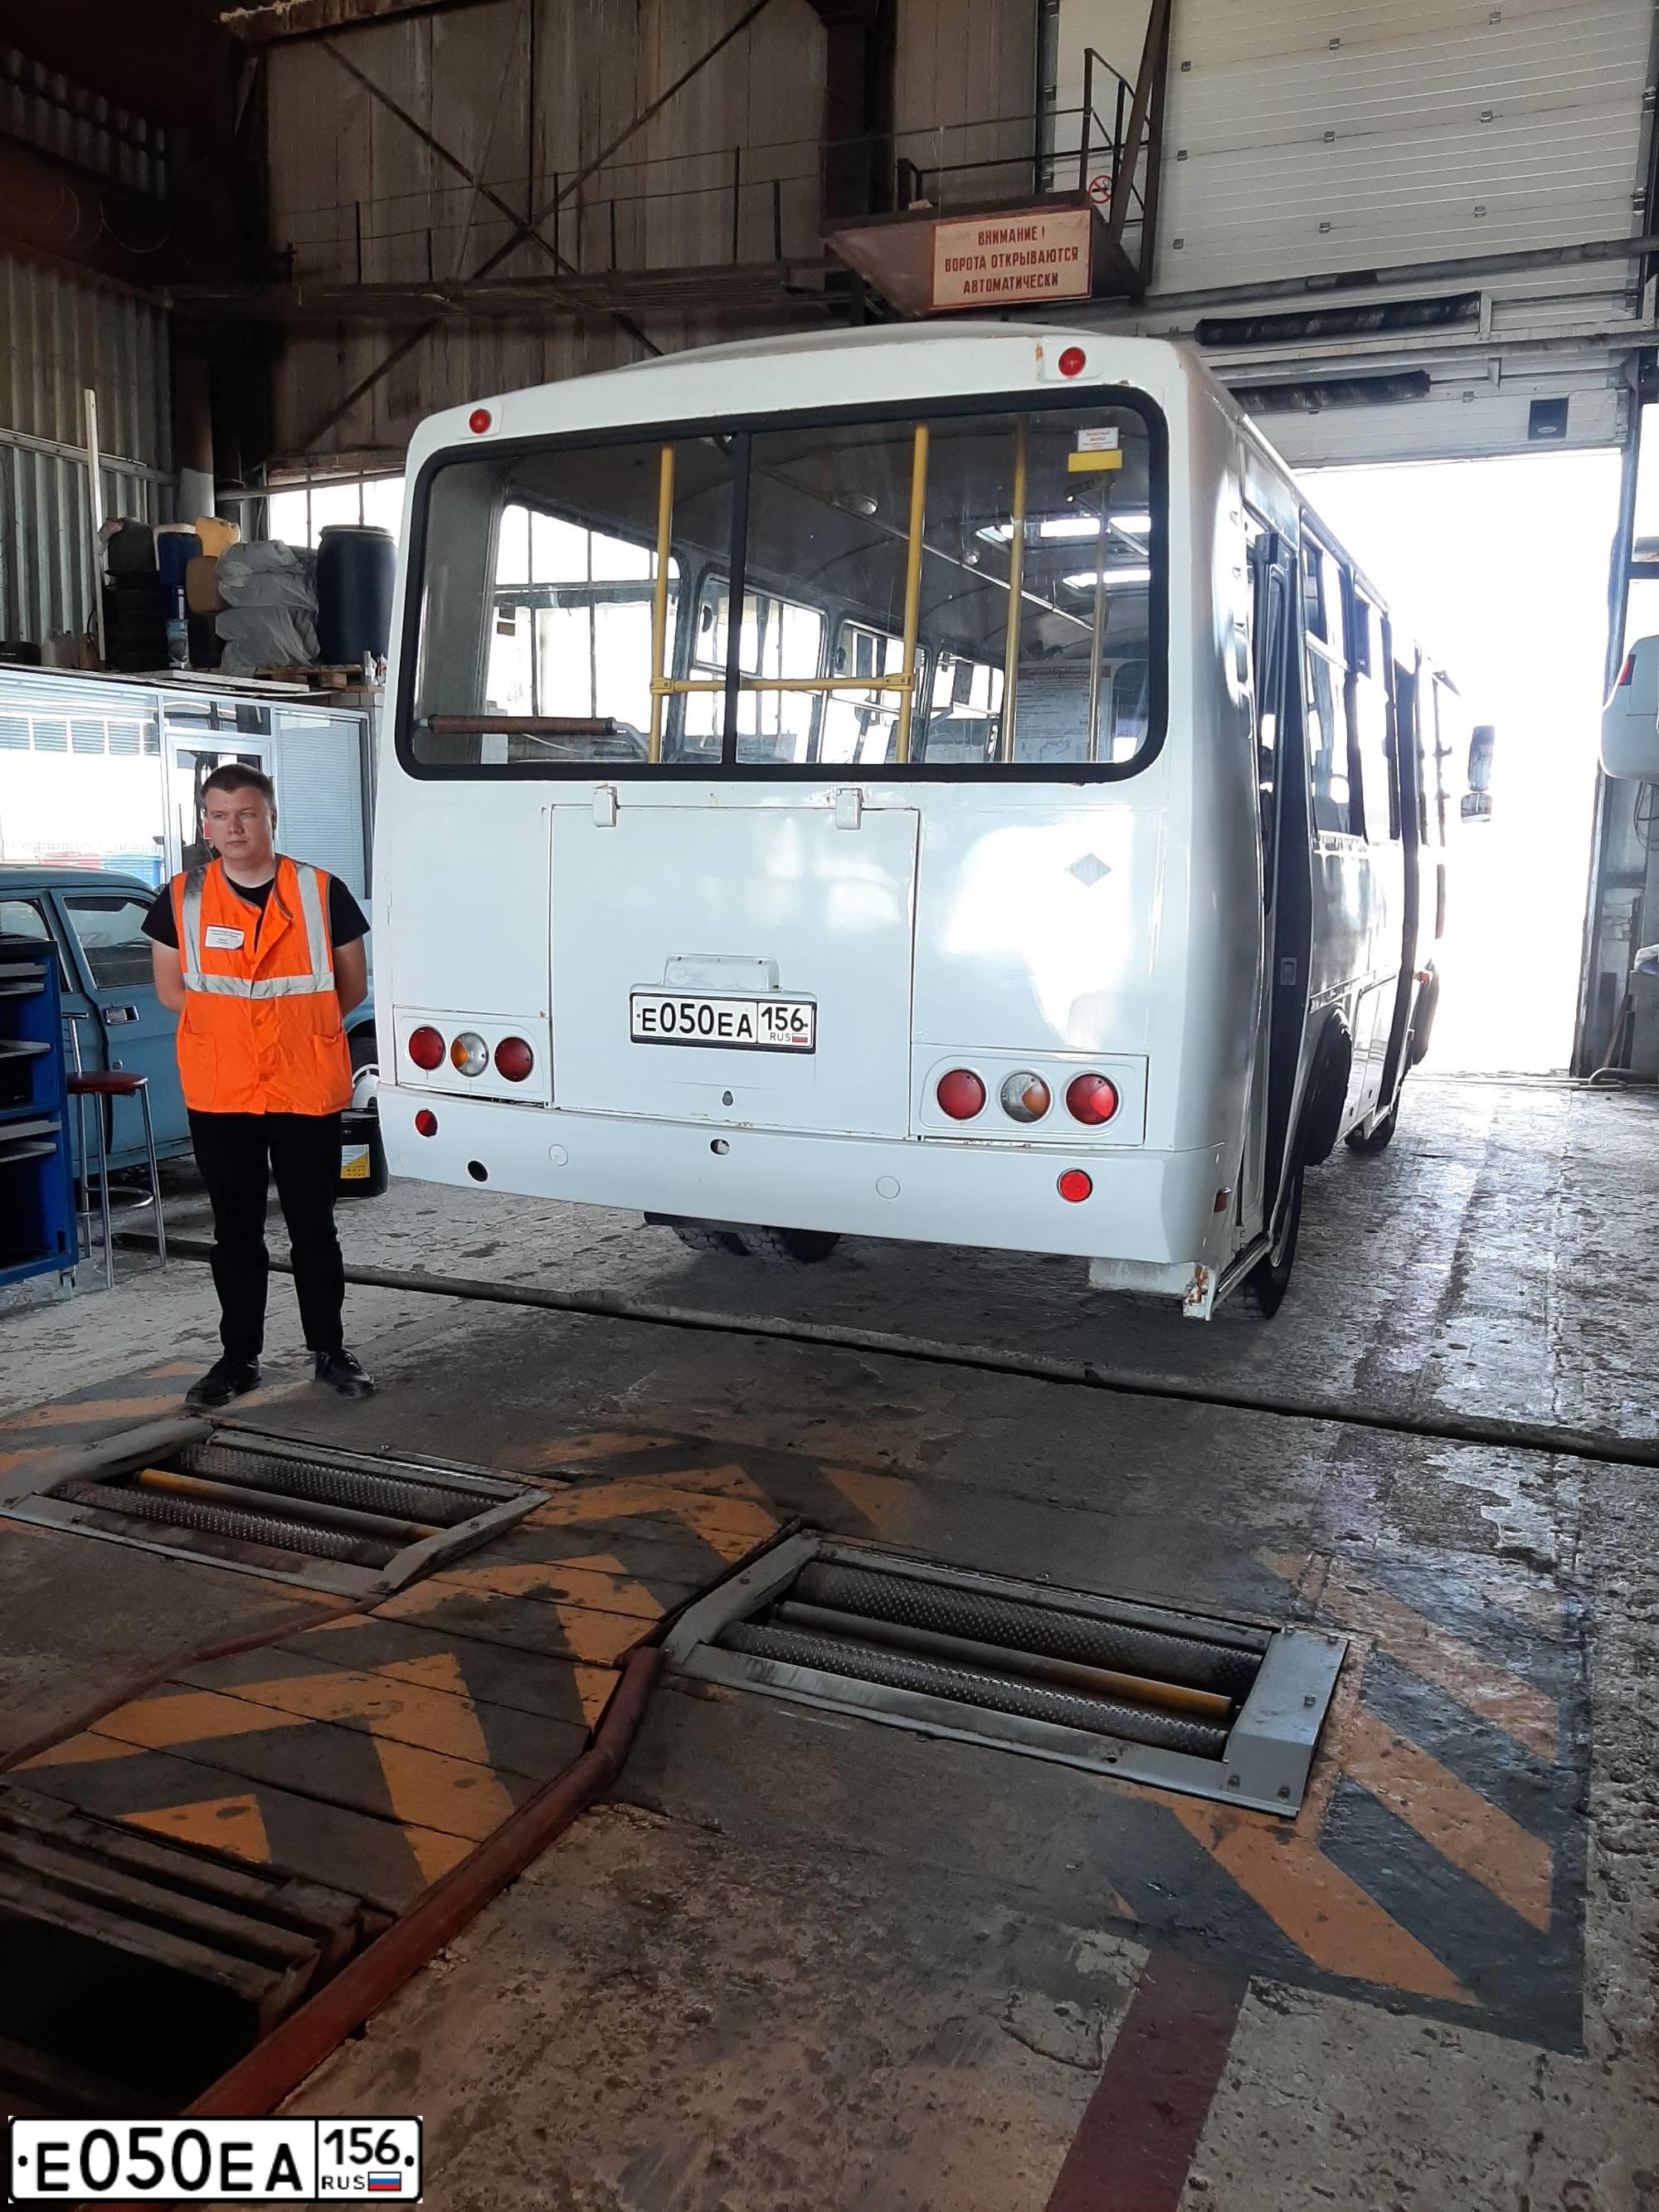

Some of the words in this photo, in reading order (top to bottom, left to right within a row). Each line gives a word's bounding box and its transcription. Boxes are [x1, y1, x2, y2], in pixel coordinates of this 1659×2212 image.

[978, 227, 1038, 246] ВНИМАНИЕ
[945, 256, 986, 273] ВОРОТА
[990, 246, 1078, 269] ОТКРЫВАЮТСЯ
[963, 272, 1058, 295] АВТОМАТИЧЕСКИ
[761, 1006, 804, 1032] 156
[769, 1031, 791, 1043] RUS
